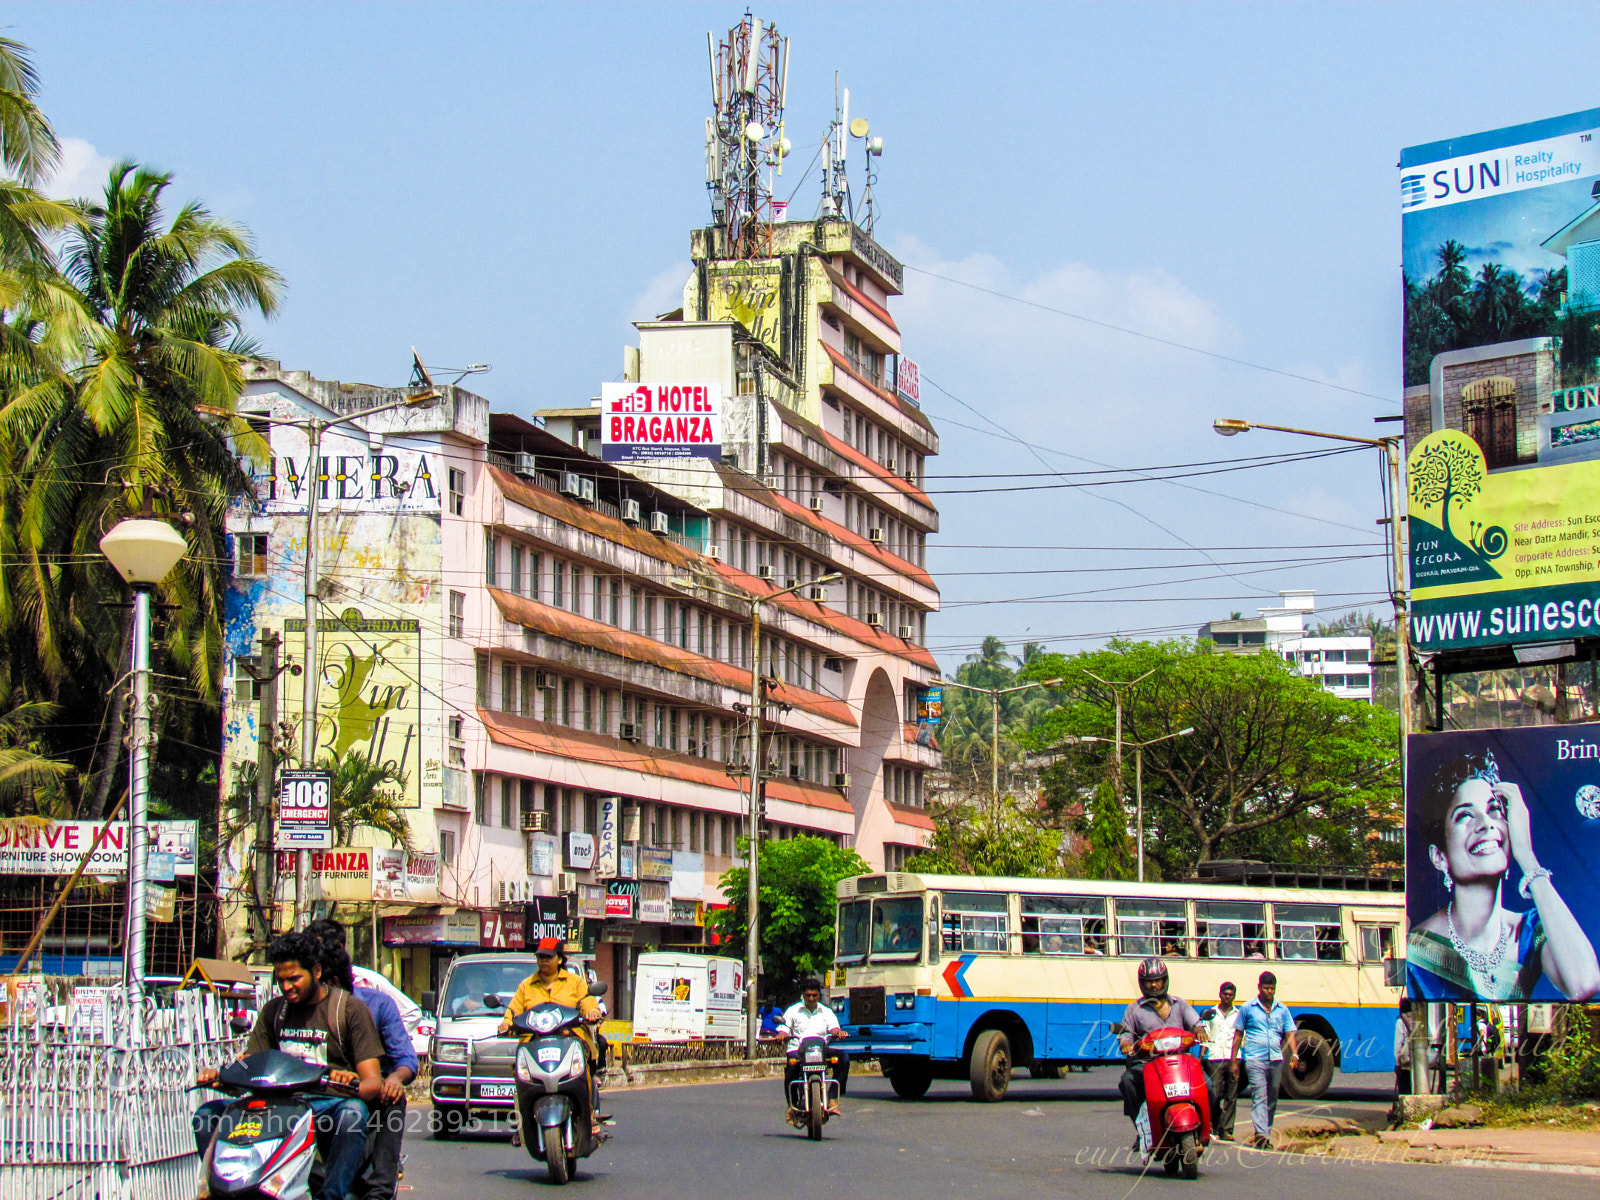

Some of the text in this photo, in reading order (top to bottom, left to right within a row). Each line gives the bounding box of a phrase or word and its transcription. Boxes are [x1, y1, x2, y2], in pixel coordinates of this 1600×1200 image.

[1579, 133, 1592, 143] TM
[1514, 151, 1553, 167] Realty
[1433, 160, 1500, 199] SUN
[1516, 161, 1582, 184] Hospitality
[622, 386, 712, 412] HB HOTEL
[611, 416, 713, 442] BRAGANZA
[240, 455, 437, 500] IVIERA
[1514, 523, 1529, 532] Site
[1531, 519, 1565, 530] Address:
[1567, 516, 1583, 526] Sun
[1416, 541, 1439, 552] SUN
[1514, 538, 1533, 547] Near
[1535, 534, 1557, 545] Datta
[1559, 530, 1590, 541] Mandir,
[1416, 552, 1462, 565] ESCORA
[1515, 551, 1553, 563] Corporate
[1556, 547, 1590, 558] Address:
[1515, 561, 1595, 579] Opp. RNA Township,
[1557, 740, 1600, 763] Brin
[284, 781, 328, 808] 108
[282, 809, 328, 819] EMERGENCY
[602, 802, 613, 840] DTDC
[93, 826, 123, 849] IN
[50, 853, 122, 862] SHOWOOM
[574, 846, 591, 857] DTDC
[276, 852, 369, 871] BRGANZA
[325, 871, 369, 879] FURNITURE
[482, 1087, 495, 1096] MH
[497, 1087, 506, 1096] 02
